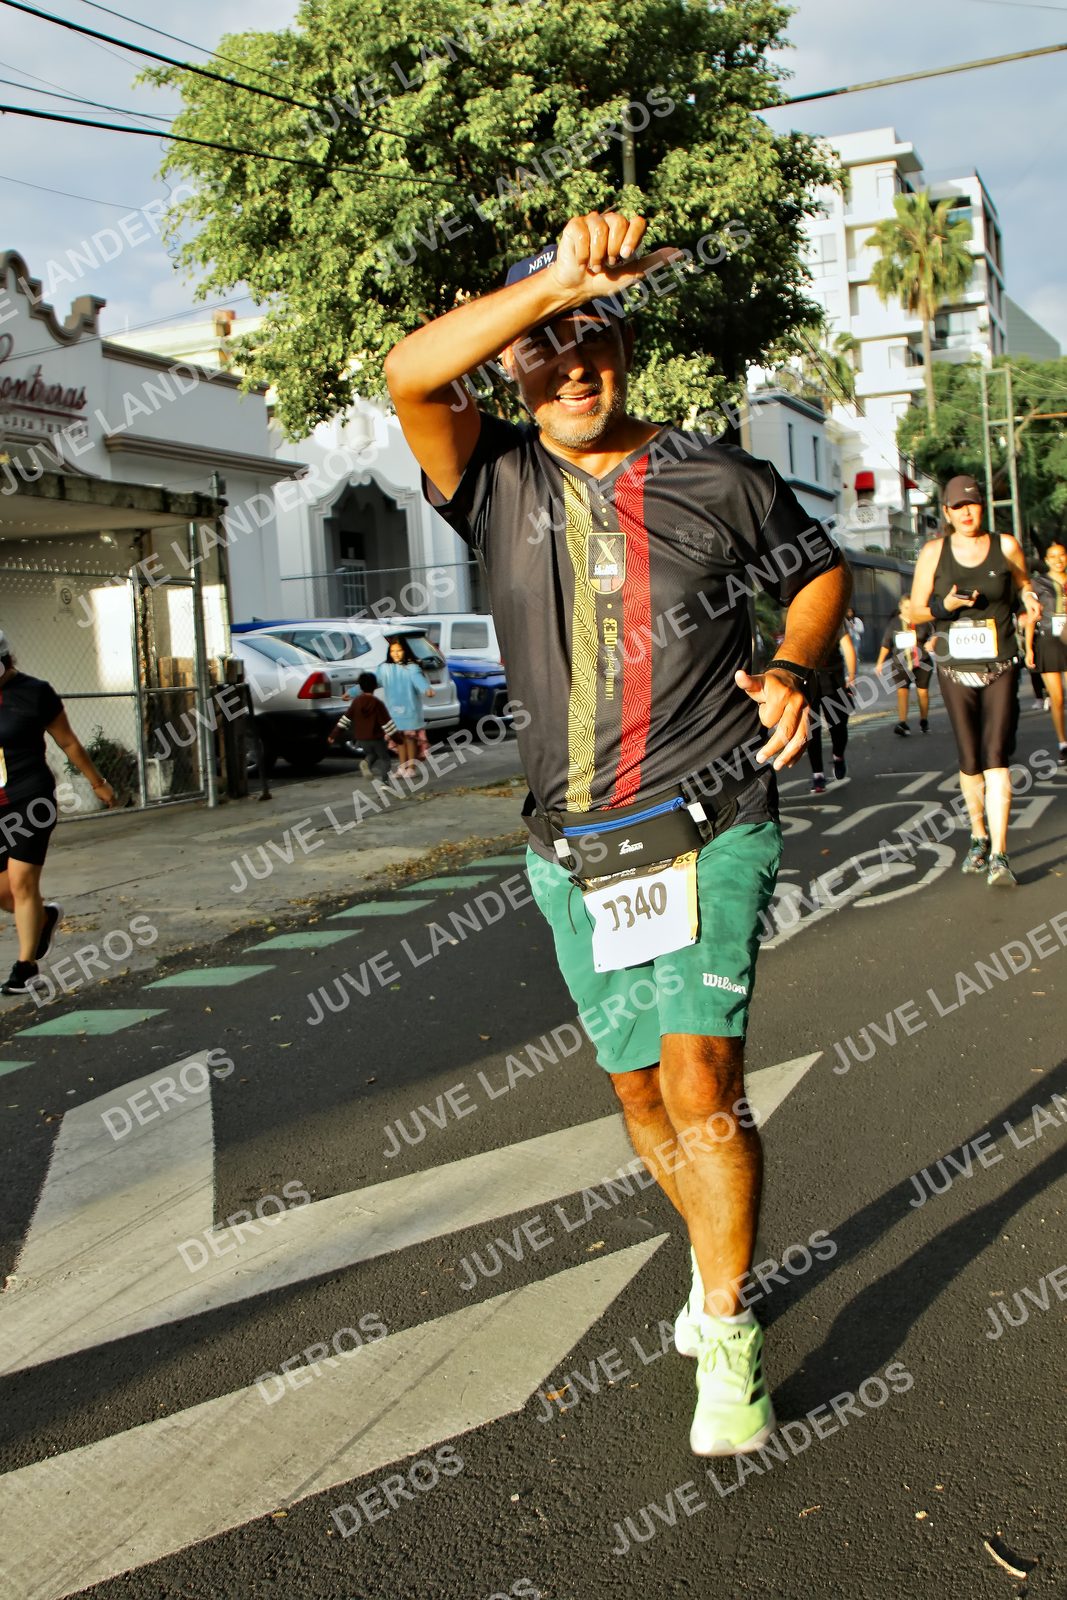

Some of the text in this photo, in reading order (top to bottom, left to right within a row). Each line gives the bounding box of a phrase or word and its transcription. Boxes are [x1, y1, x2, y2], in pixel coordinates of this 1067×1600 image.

[529, 251, 554, 274] NEW
[956, 633, 986, 645] 6690
[702, 972, 747, 995] Wilson
